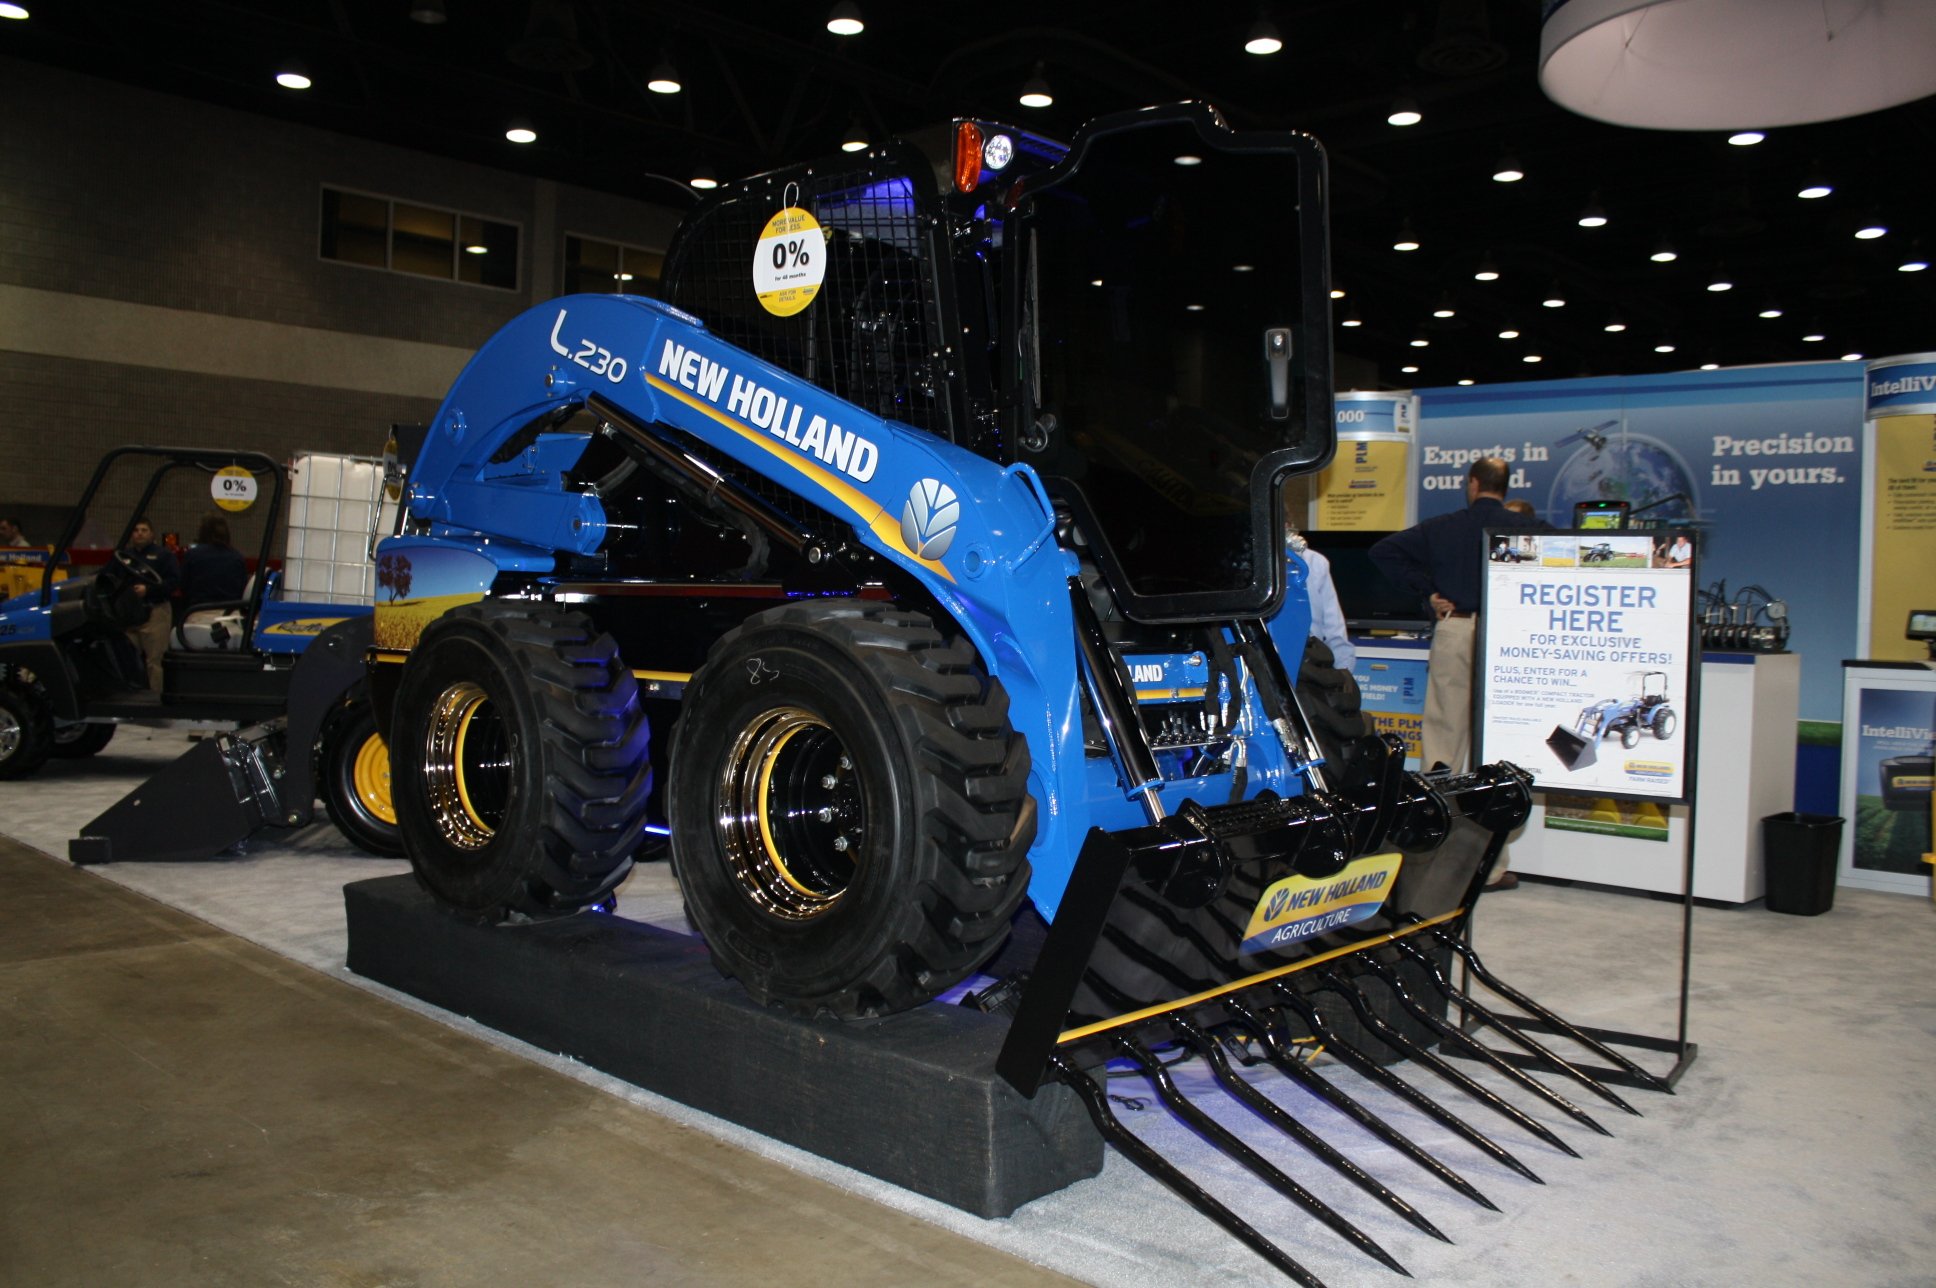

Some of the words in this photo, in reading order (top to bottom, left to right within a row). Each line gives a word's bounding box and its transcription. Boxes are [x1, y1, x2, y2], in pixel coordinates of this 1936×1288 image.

[773, 239, 809, 269] 0%
[659, 339, 728, 403] NEW
[727, 375, 879, 483] HOLLAND
[1423, 444, 1517, 468] Experts
[1522, 442, 1549, 462] in
[1712, 432, 1854, 457] Precision
[223, 480, 247, 492] 0%
[1423, 474, 1465, 490] our
[1711, 464, 1741, 486] in
[1750, 467, 1845, 490] yours.
[1520, 583, 1656, 608] REGISTER
[1549, 609, 1623, 633] HERE
[1529, 634, 1557, 645] FOR
[1561, 635, 1642, 649] EXCLUSIVE
[1500, 646, 1606, 662] MONEY-SAVING
[1610, 649, 1673, 664] OFFERS!
[1493, 675, 1533, 685] CHANCE
[1536, 677, 1549, 686] TO
[1494, 666, 1520, 676] PLUS,
[1524, 667, 1554, 677] ENTER
[1558, 668, 1578, 678] FOR
[1581, 669, 1588, 678] A
[1398, 718, 1422, 729] PLM
[1286, 886, 1325, 912] NEW
[1324, 870, 1388, 905] HOLLAND
[1271, 908, 1353, 944] AGRICULTURE
